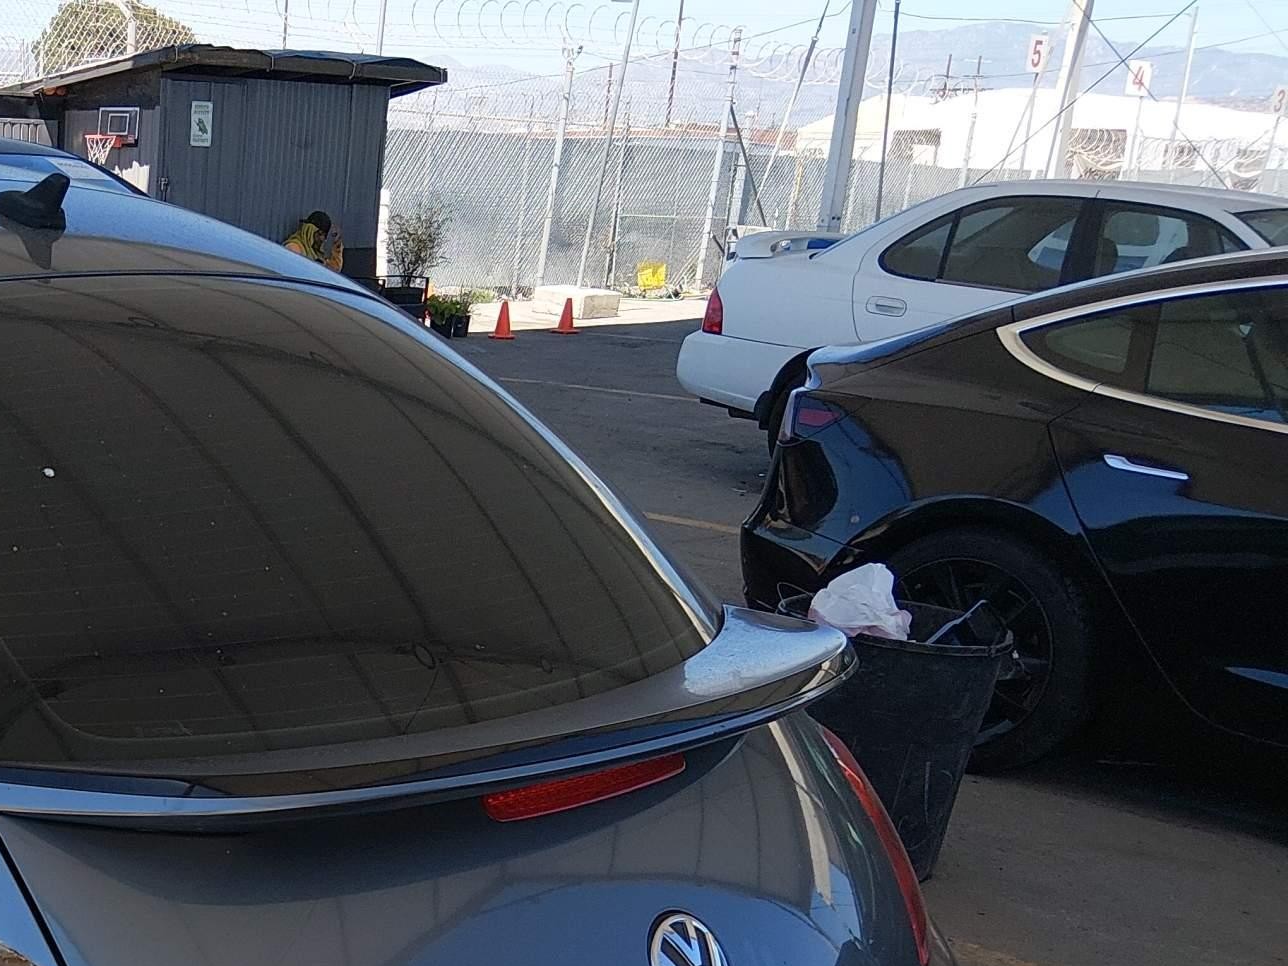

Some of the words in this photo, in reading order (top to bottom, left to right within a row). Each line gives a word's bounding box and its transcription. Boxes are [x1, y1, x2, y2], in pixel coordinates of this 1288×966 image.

[1031, 39, 1043, 68] 5
[1132, 65, 1145, 91] 4
[1274, 89, 1286, 113] 3
